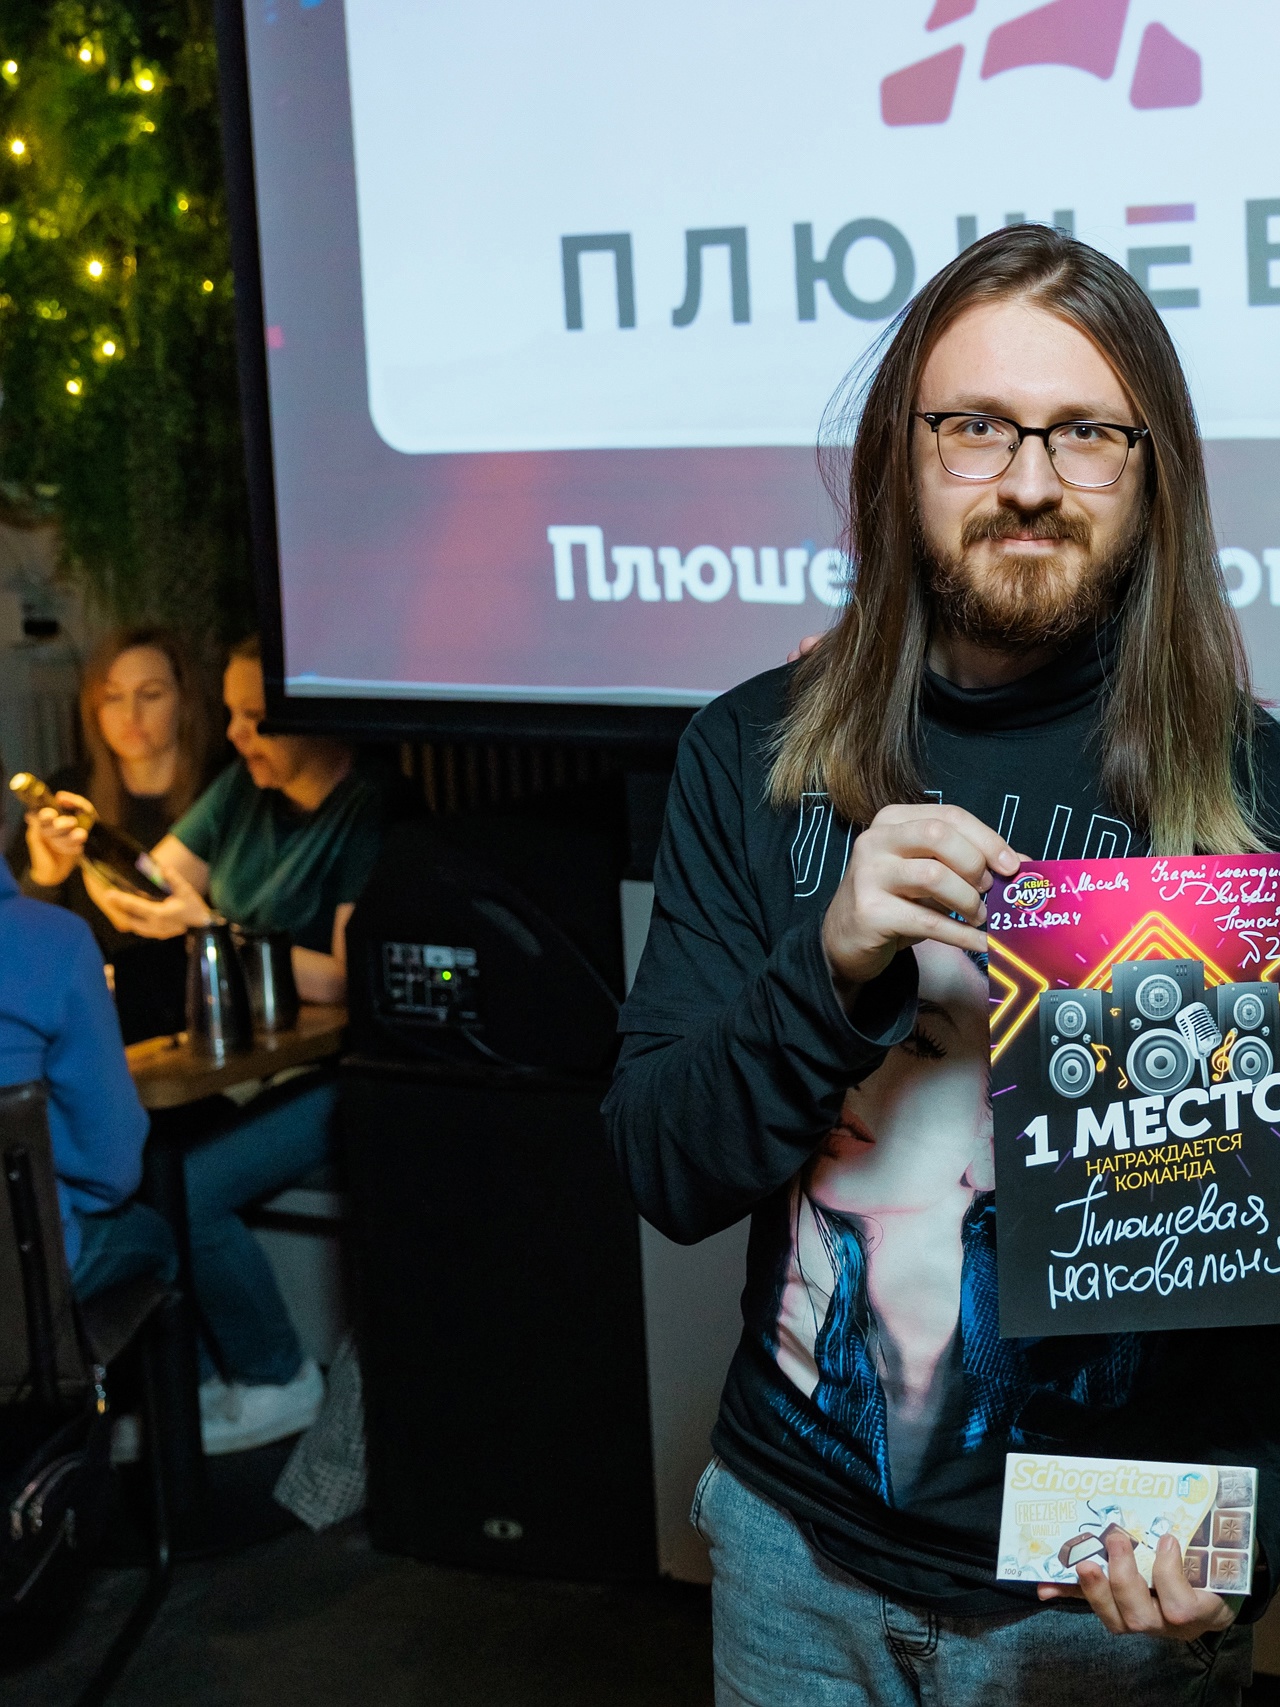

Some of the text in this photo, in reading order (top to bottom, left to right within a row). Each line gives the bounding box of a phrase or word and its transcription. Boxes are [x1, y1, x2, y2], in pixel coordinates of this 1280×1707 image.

[547, 525, 857, 608] Плюше
[1003, 883, 1056, 904] Смузи
[1024, 879, 1050, 889] КВИЗ
[1150, 860, 1206, 896] Угадай
[990, 911, 1082, 931] 23.11.2024
[1024, 1114, 1059, 1167] 1
[1085, 1133, 1243, 1177] НАГРАЖДАЕТСЯ
[1115, 1158, 1217, 1192] КОМАНДА
[1050, 1173, 1270, 1259] Плюшевая
[1013, 1460, 1172, 1498] Schogetten
[1018, 1501, 1075, 1523] FREEZE ME
[1032, 1524, 1061, 1536] VANILLA
[1004, 1568, 1017, 1576] 100
